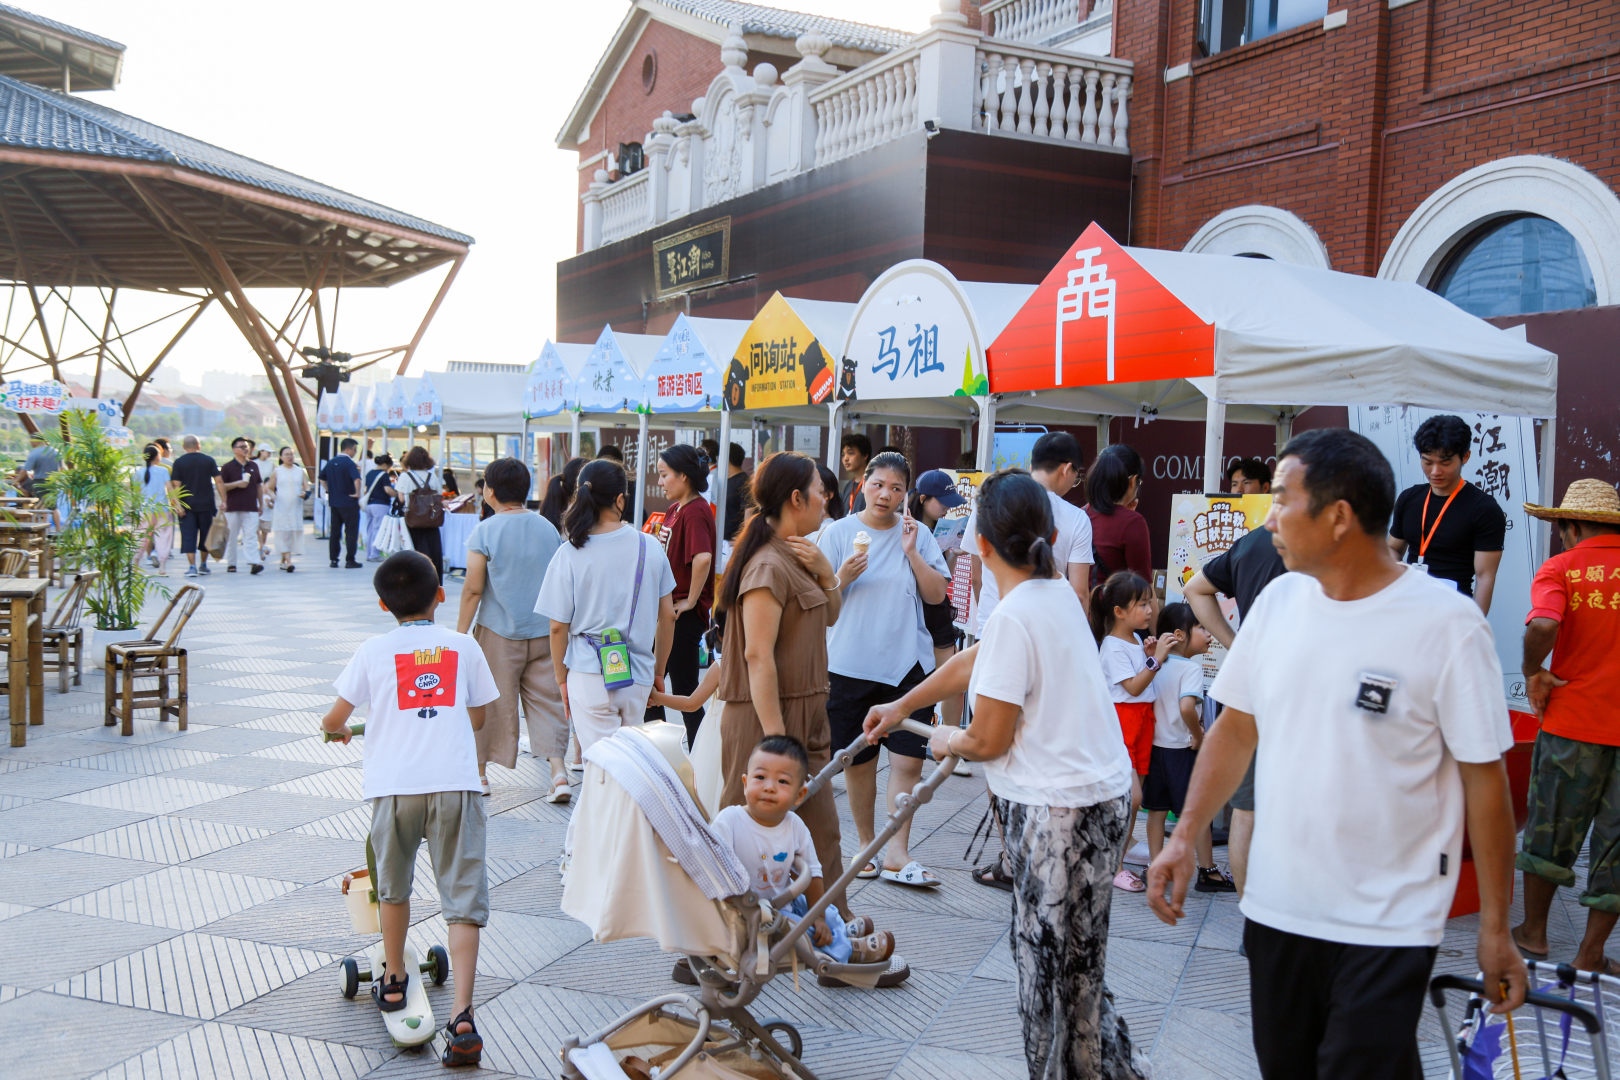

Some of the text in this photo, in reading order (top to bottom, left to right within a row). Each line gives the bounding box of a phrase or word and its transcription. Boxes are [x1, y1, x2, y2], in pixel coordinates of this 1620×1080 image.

[750, 336, 797, 377] 问询站
[872, 323, 945, 382] 马祖
[7, 380, 62, 397] 马祖旅游
[658, 372, 703, 397] 旅游咨询区
[752, 379, 795, 392] INFORMATION STATION
